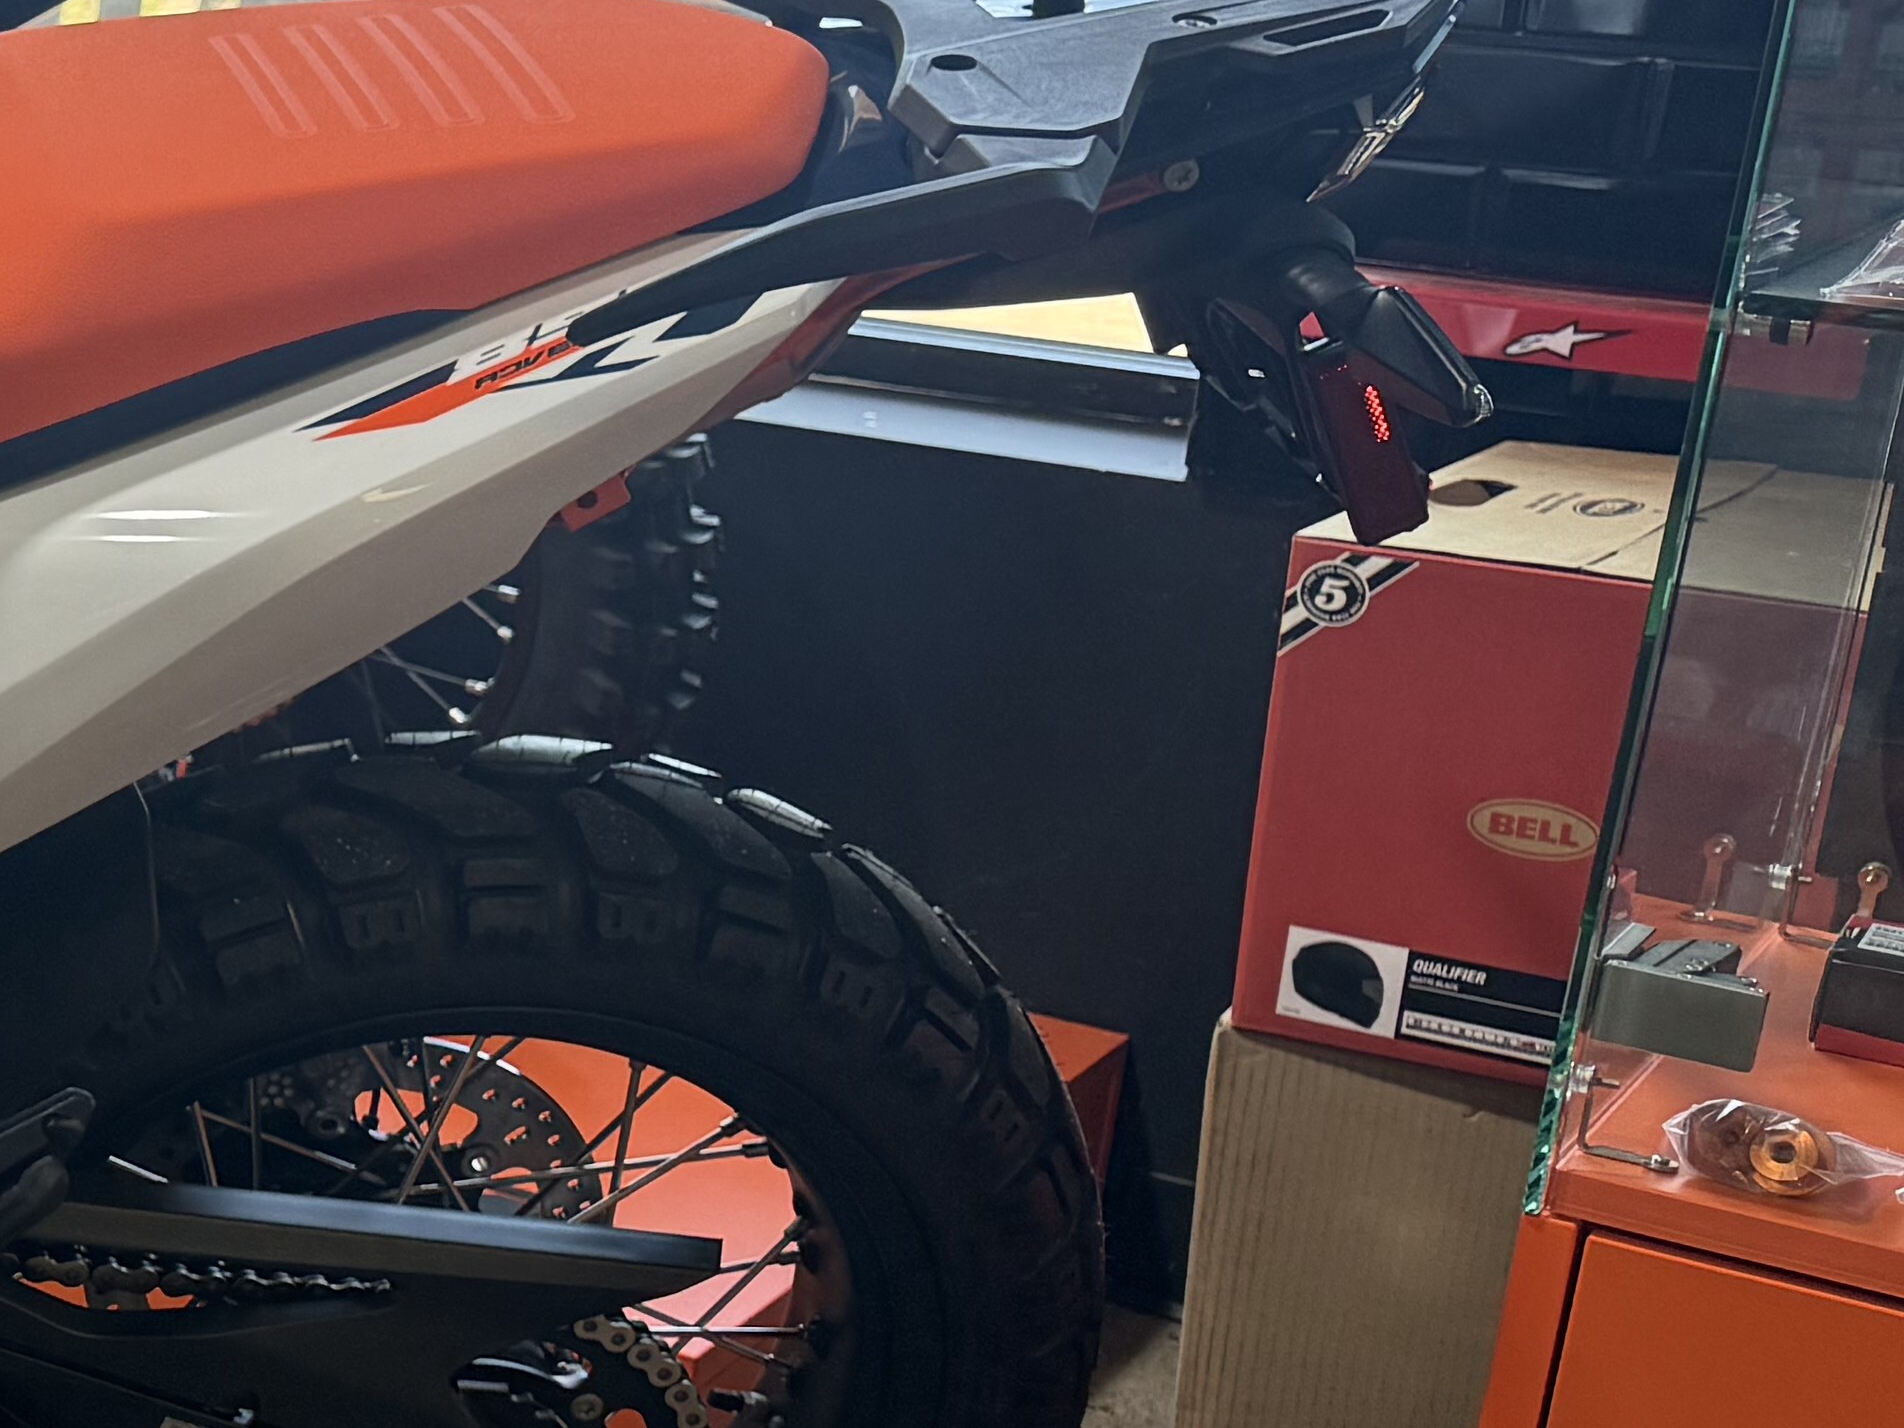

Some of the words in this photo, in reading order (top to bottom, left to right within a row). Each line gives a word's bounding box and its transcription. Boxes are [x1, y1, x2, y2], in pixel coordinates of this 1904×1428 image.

[1314, 576, 1350, 612] 5
[1488, 812, 1579, 848] BELL
[1412, 959, 1487, 986] QUALIFIER
